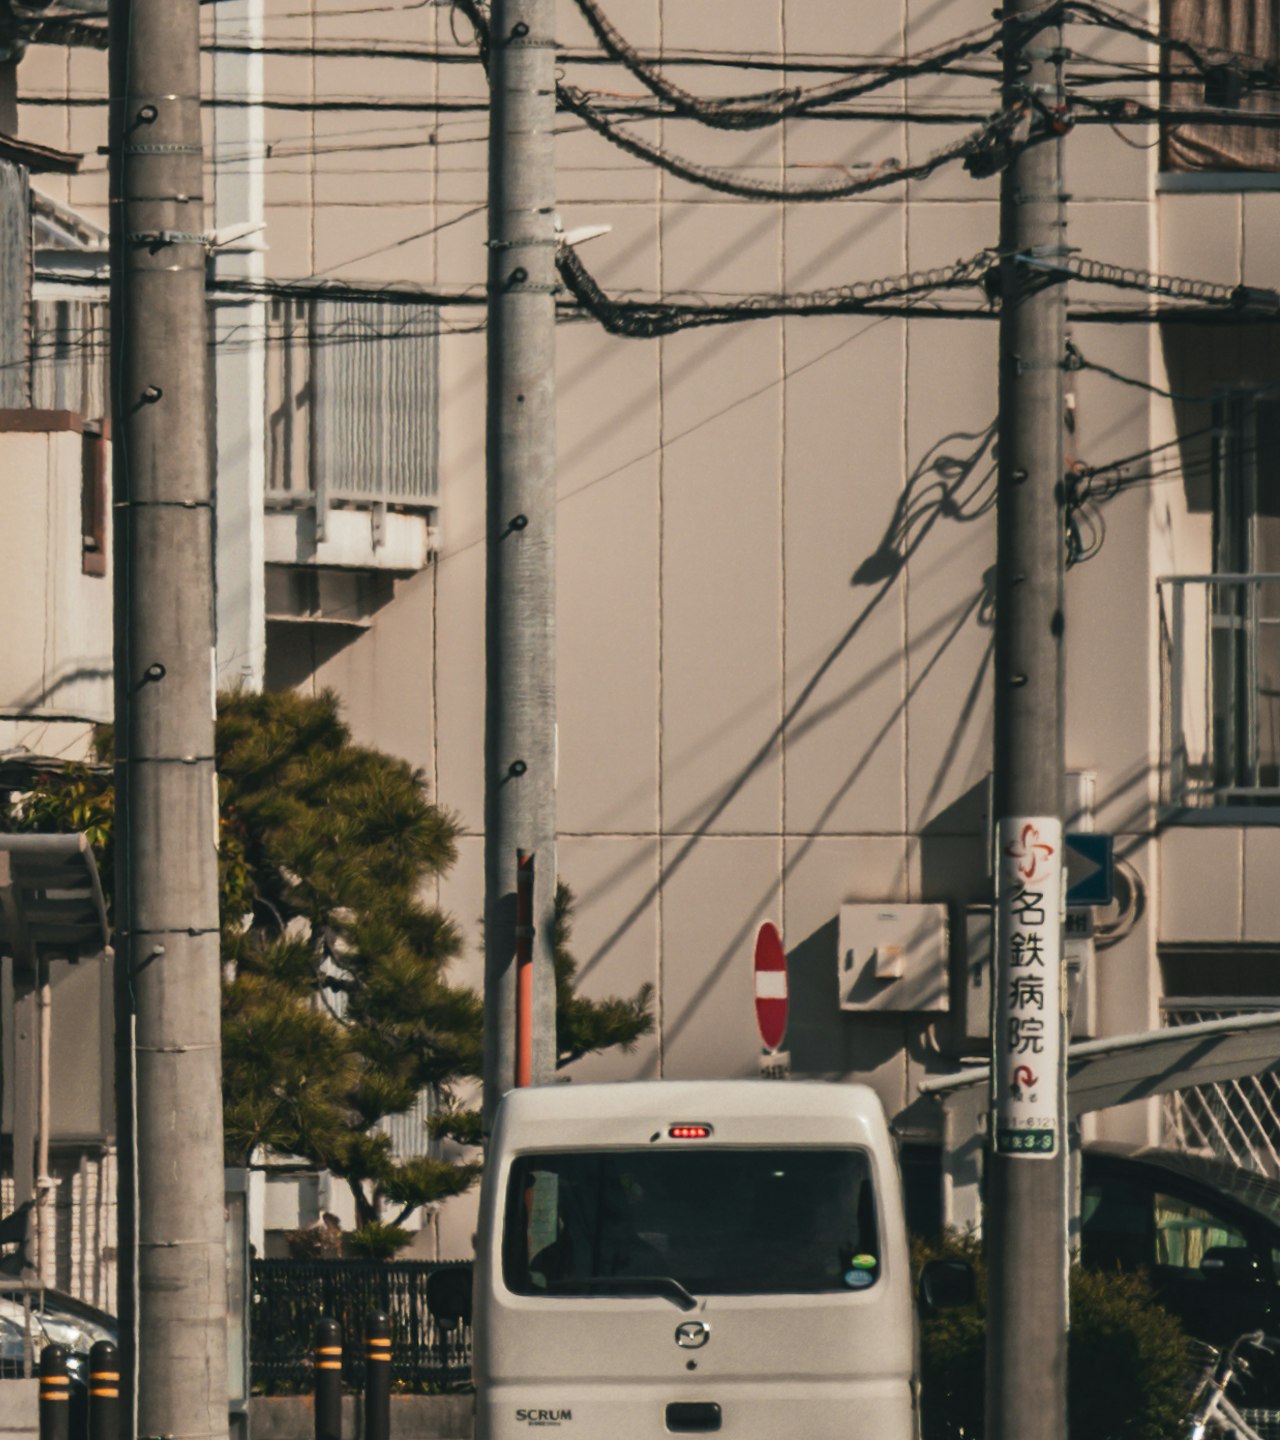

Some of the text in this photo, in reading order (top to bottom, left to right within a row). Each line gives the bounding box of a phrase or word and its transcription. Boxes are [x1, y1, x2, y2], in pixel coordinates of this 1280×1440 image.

[1008, 889, 1045, 1055] 名鉄病院
[515, 1409, 572, 1421] SCRUM
